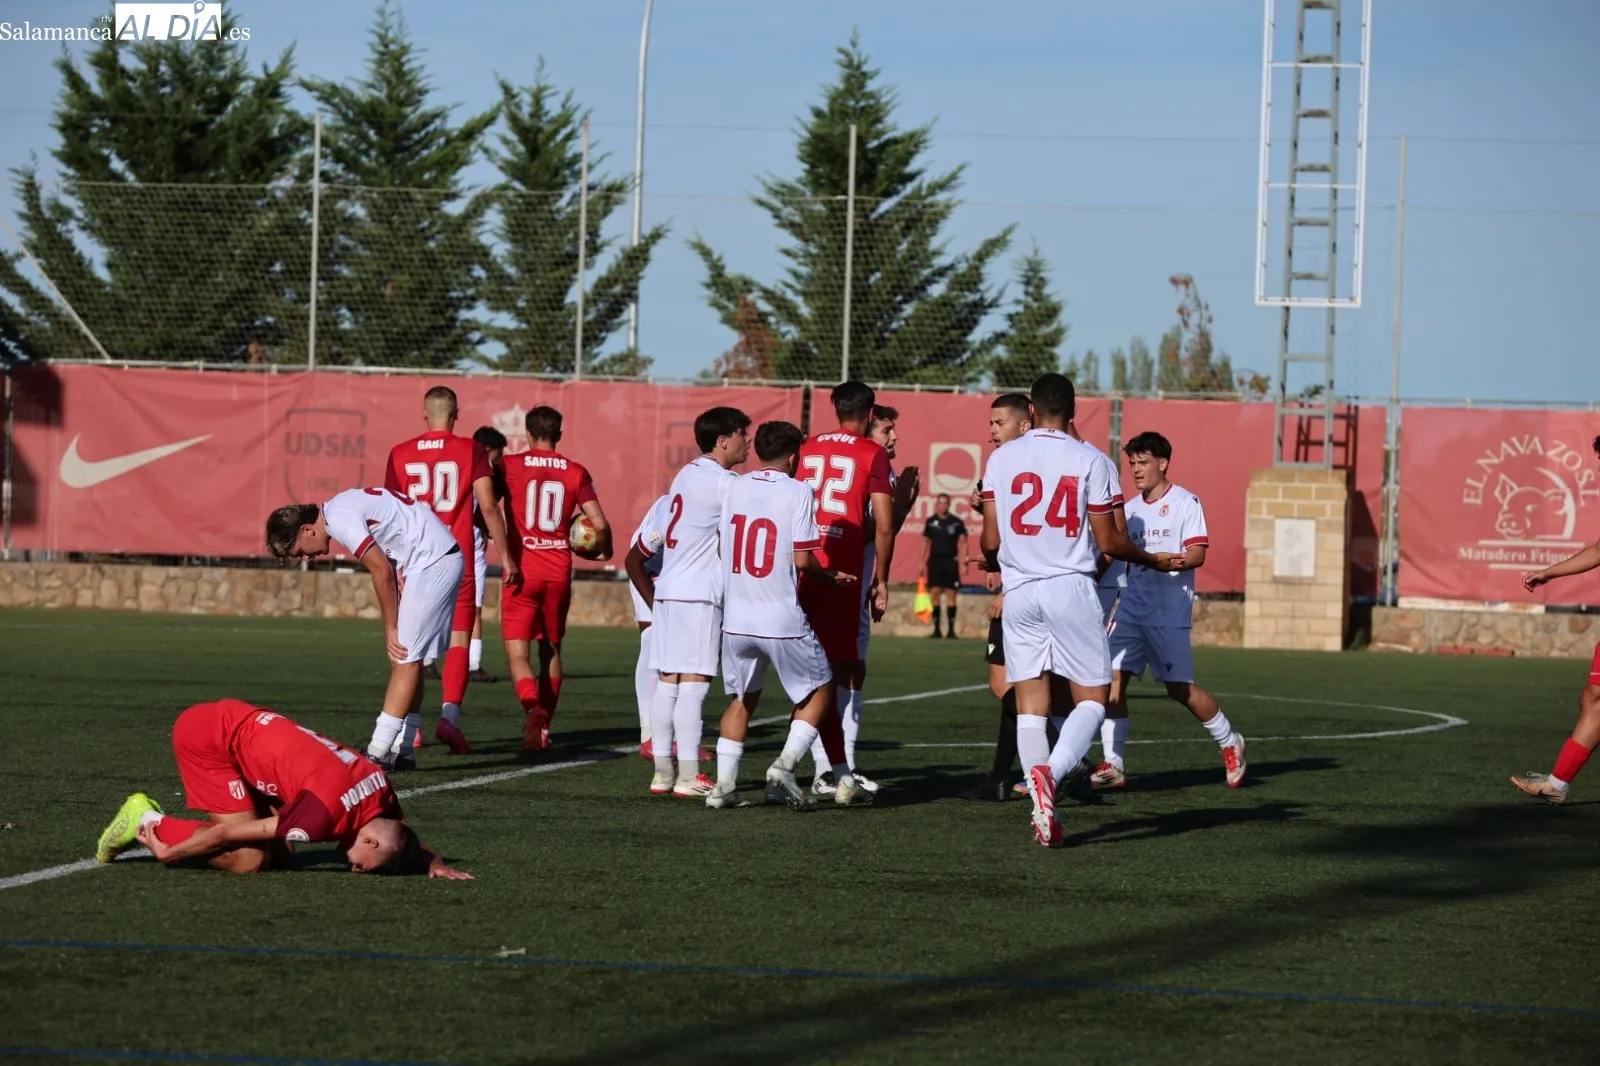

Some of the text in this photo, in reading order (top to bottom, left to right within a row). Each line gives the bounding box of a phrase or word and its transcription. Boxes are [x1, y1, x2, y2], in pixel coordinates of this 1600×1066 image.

[285, 432, 366, 457] UDSM
[417, 439, 444, 450] GABI
[524, 455, 567, 470] SANTOS
[404, 461, 459, 512] 20
[525, 479, 565, 532] 10
[803, 454, 856, 516] 22
[1010, 472, 1081, 537] 24
[665, 493, 684, 549] 2
[730, 514, 777, 578] 10
[1131, 528, 1171, 541] SPIRE
[1459, 547, 1527, 562] Matadero
